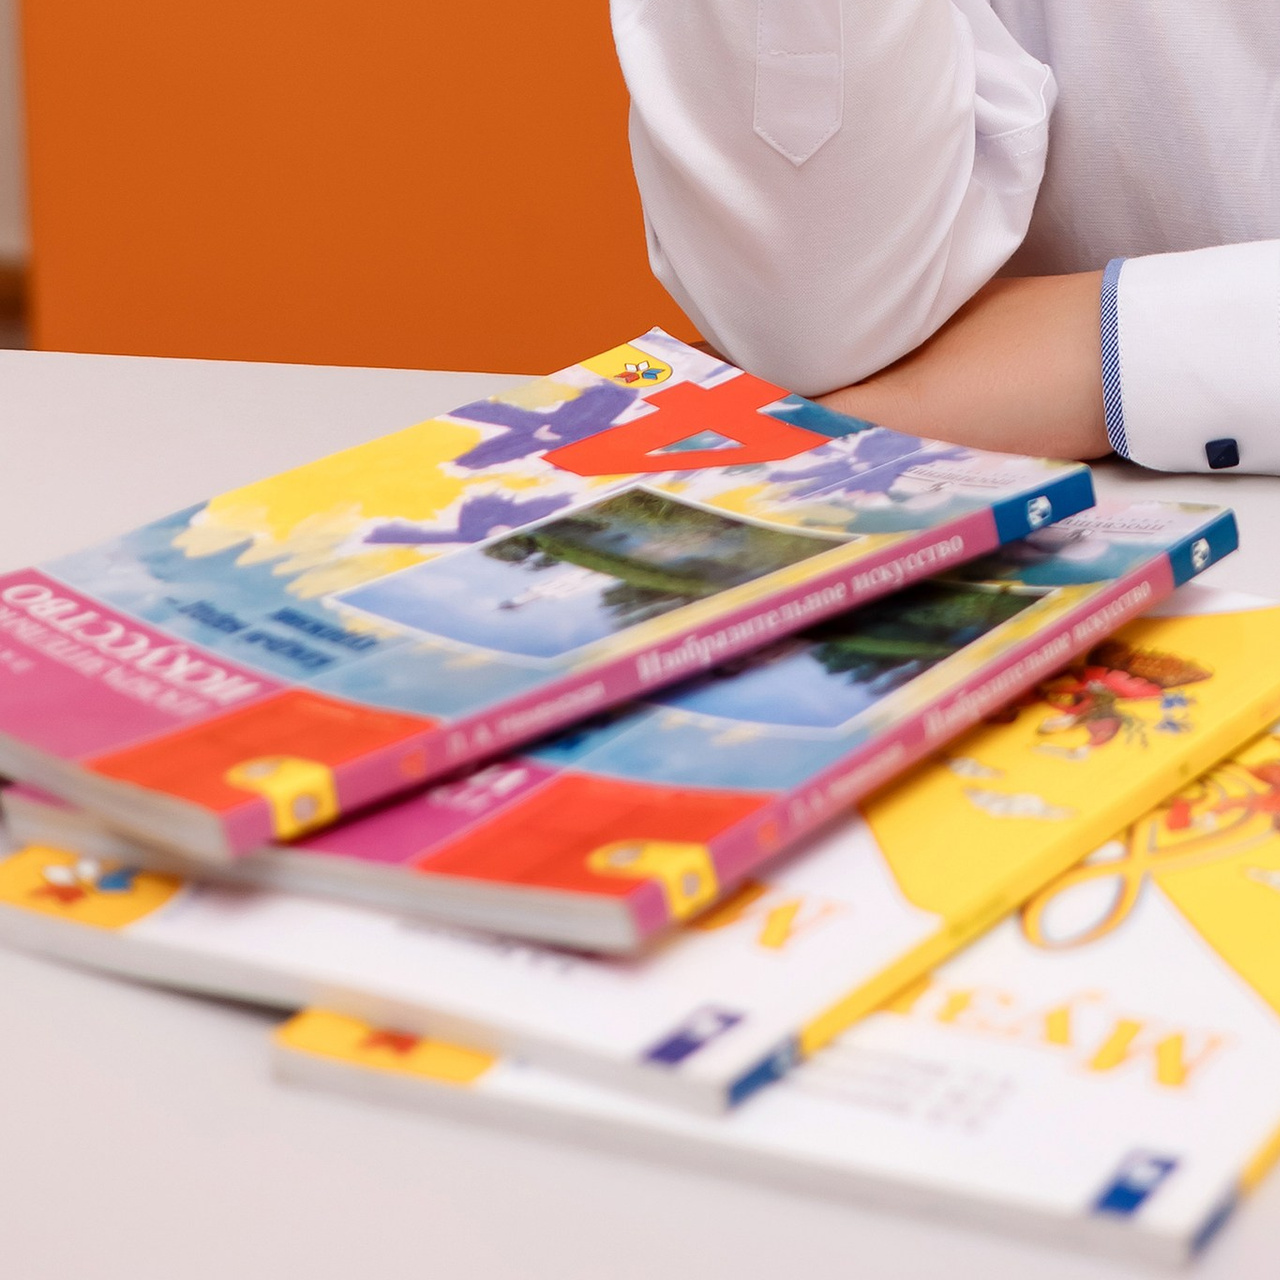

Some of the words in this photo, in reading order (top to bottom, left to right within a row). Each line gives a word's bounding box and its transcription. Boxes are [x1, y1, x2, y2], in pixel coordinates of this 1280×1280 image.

[540, 372, 833, 478] 4
[853, 533, 964, 594] искусство
[1, 584, 259, 706] ИСКУССТВО
